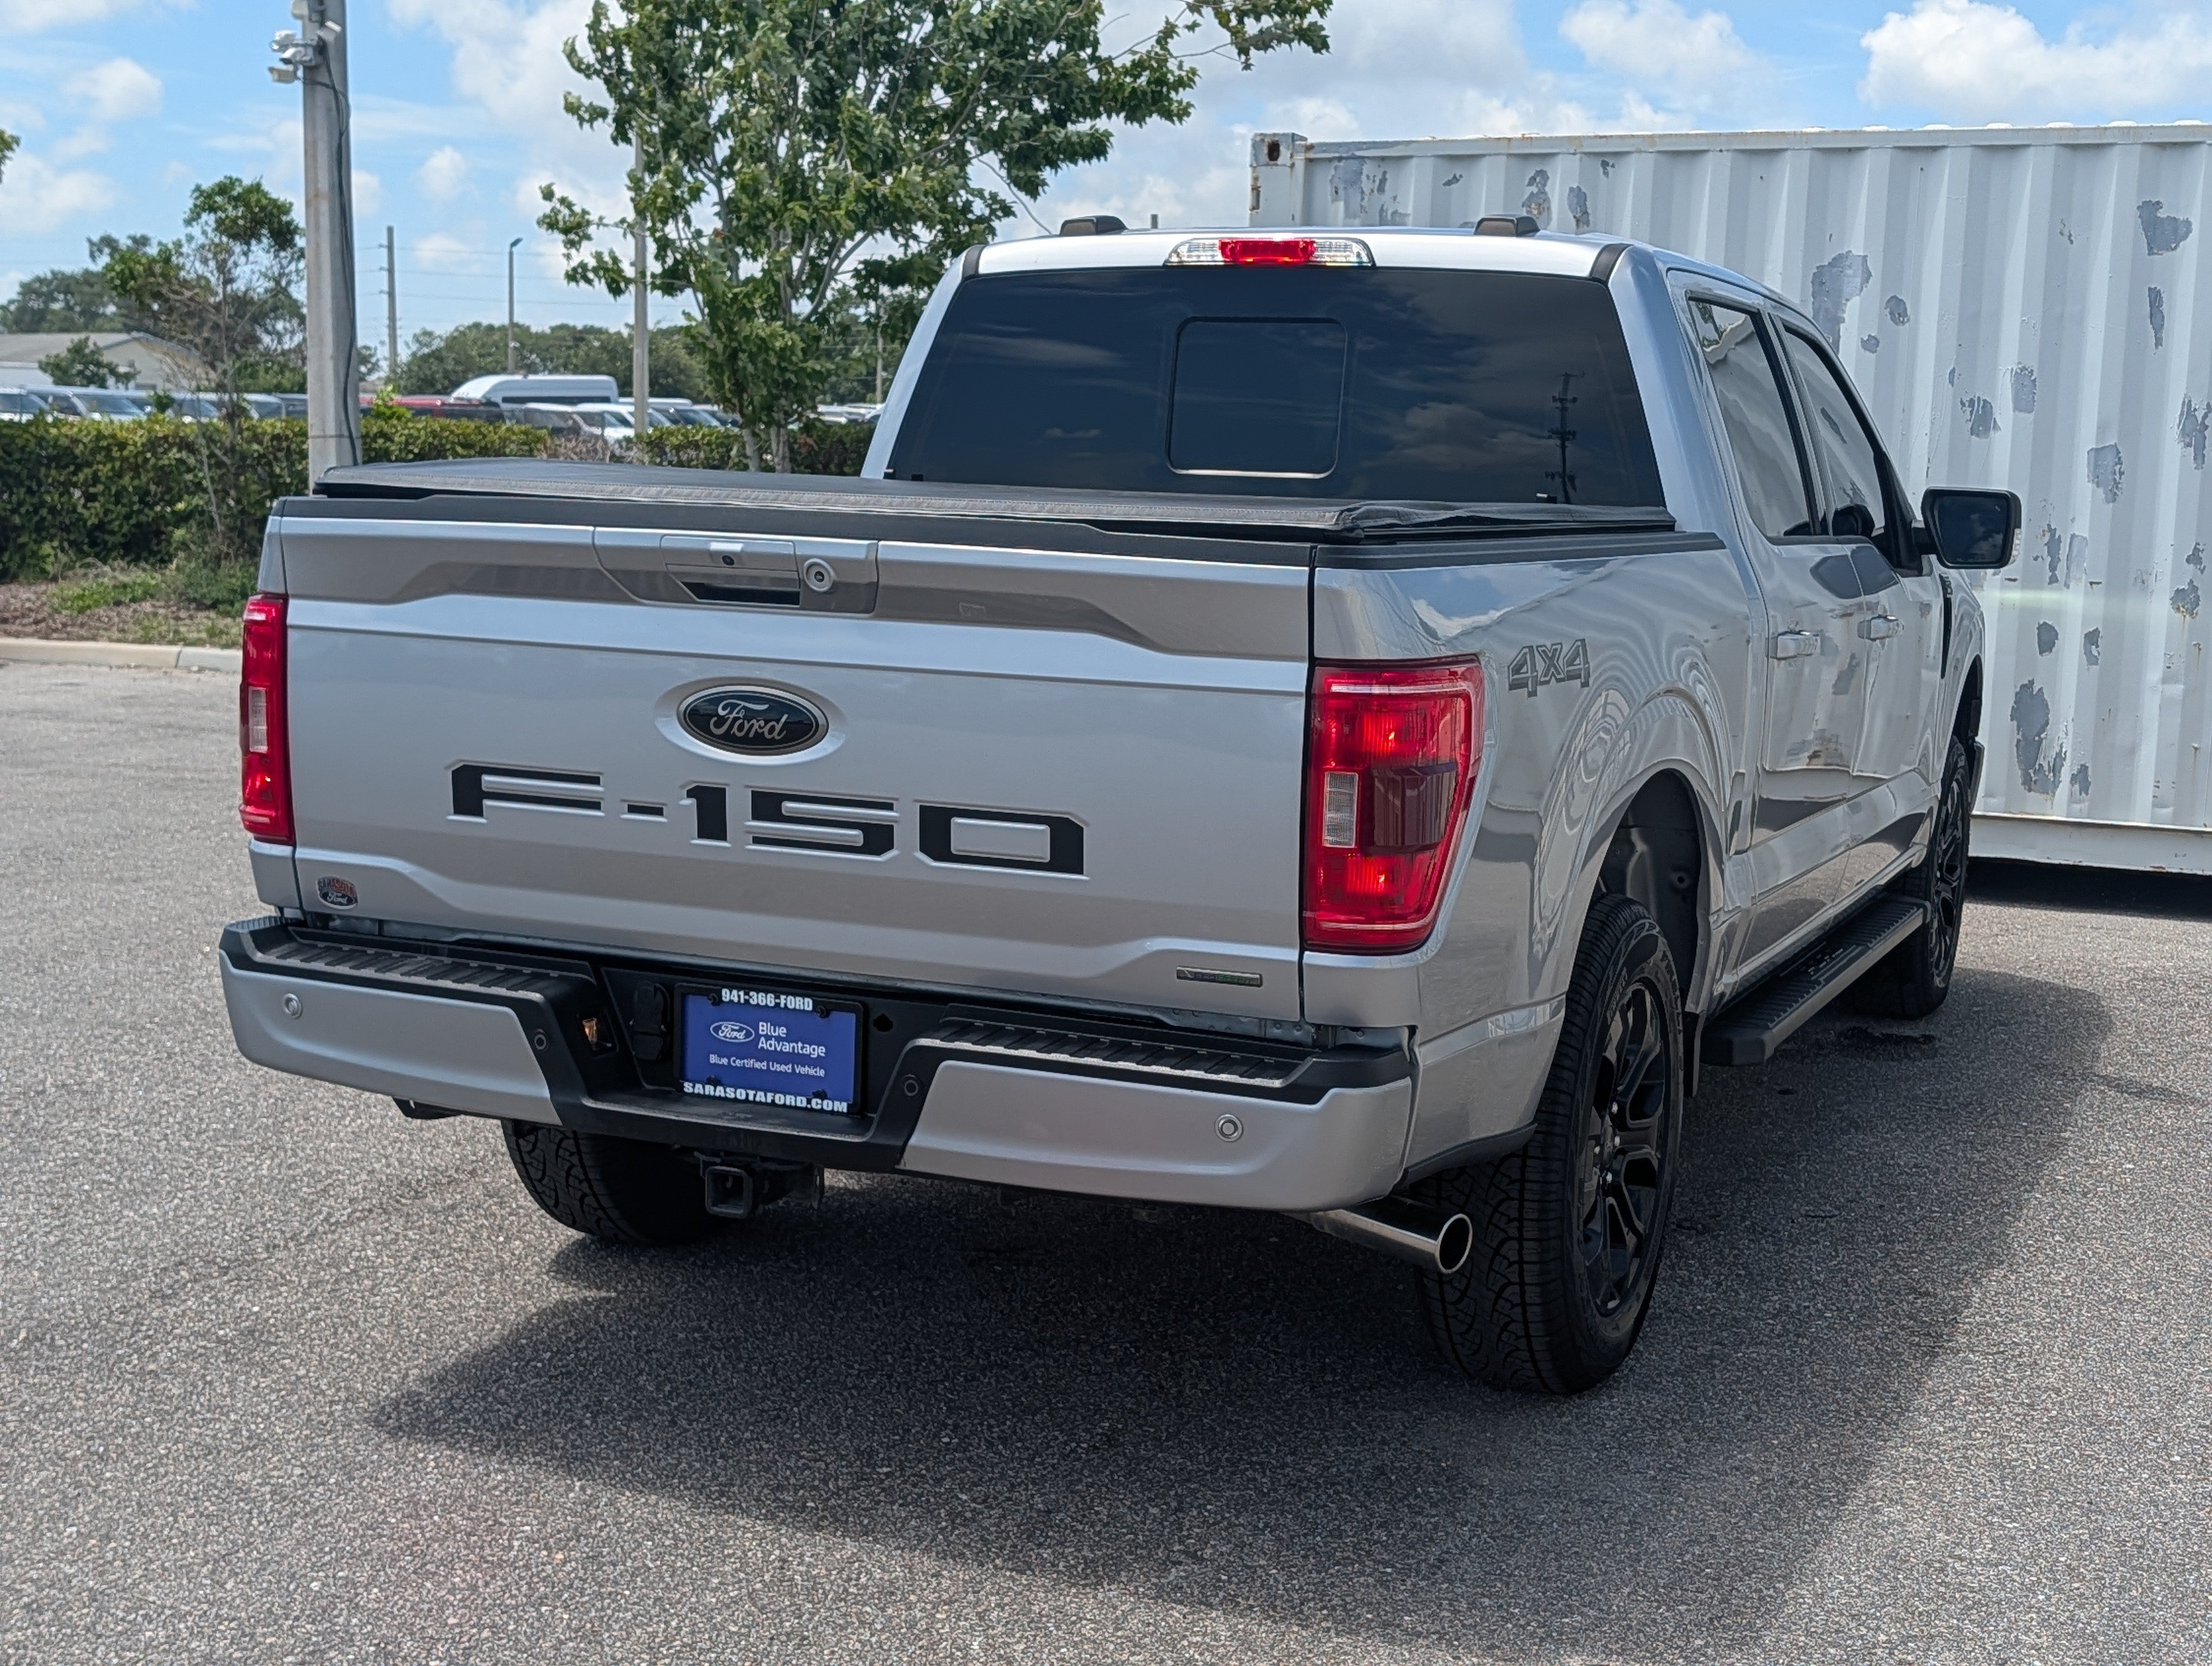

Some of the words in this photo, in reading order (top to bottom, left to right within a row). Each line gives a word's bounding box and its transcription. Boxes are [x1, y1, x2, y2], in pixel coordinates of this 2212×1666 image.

[710, 699, 788, 740] Ford
[449, 761, 1087, 878] F-150
[721, 988, 813, 1011] 941-366-FORD
[718, 1022, 747, 1040] Ford
[758, 1021, 787, 1037] Blue
[758, 1037, 826, 1058] Advantage
[709, 1054, 728, 1066] Blue
[730, 1056, 767, 1070] Certified
[769, 1061, 792, 1073] Used
[794, 1064, 825, 1078] Vehicle
[683, 1081, 848, 1113] SARASOTAFORD.COM
